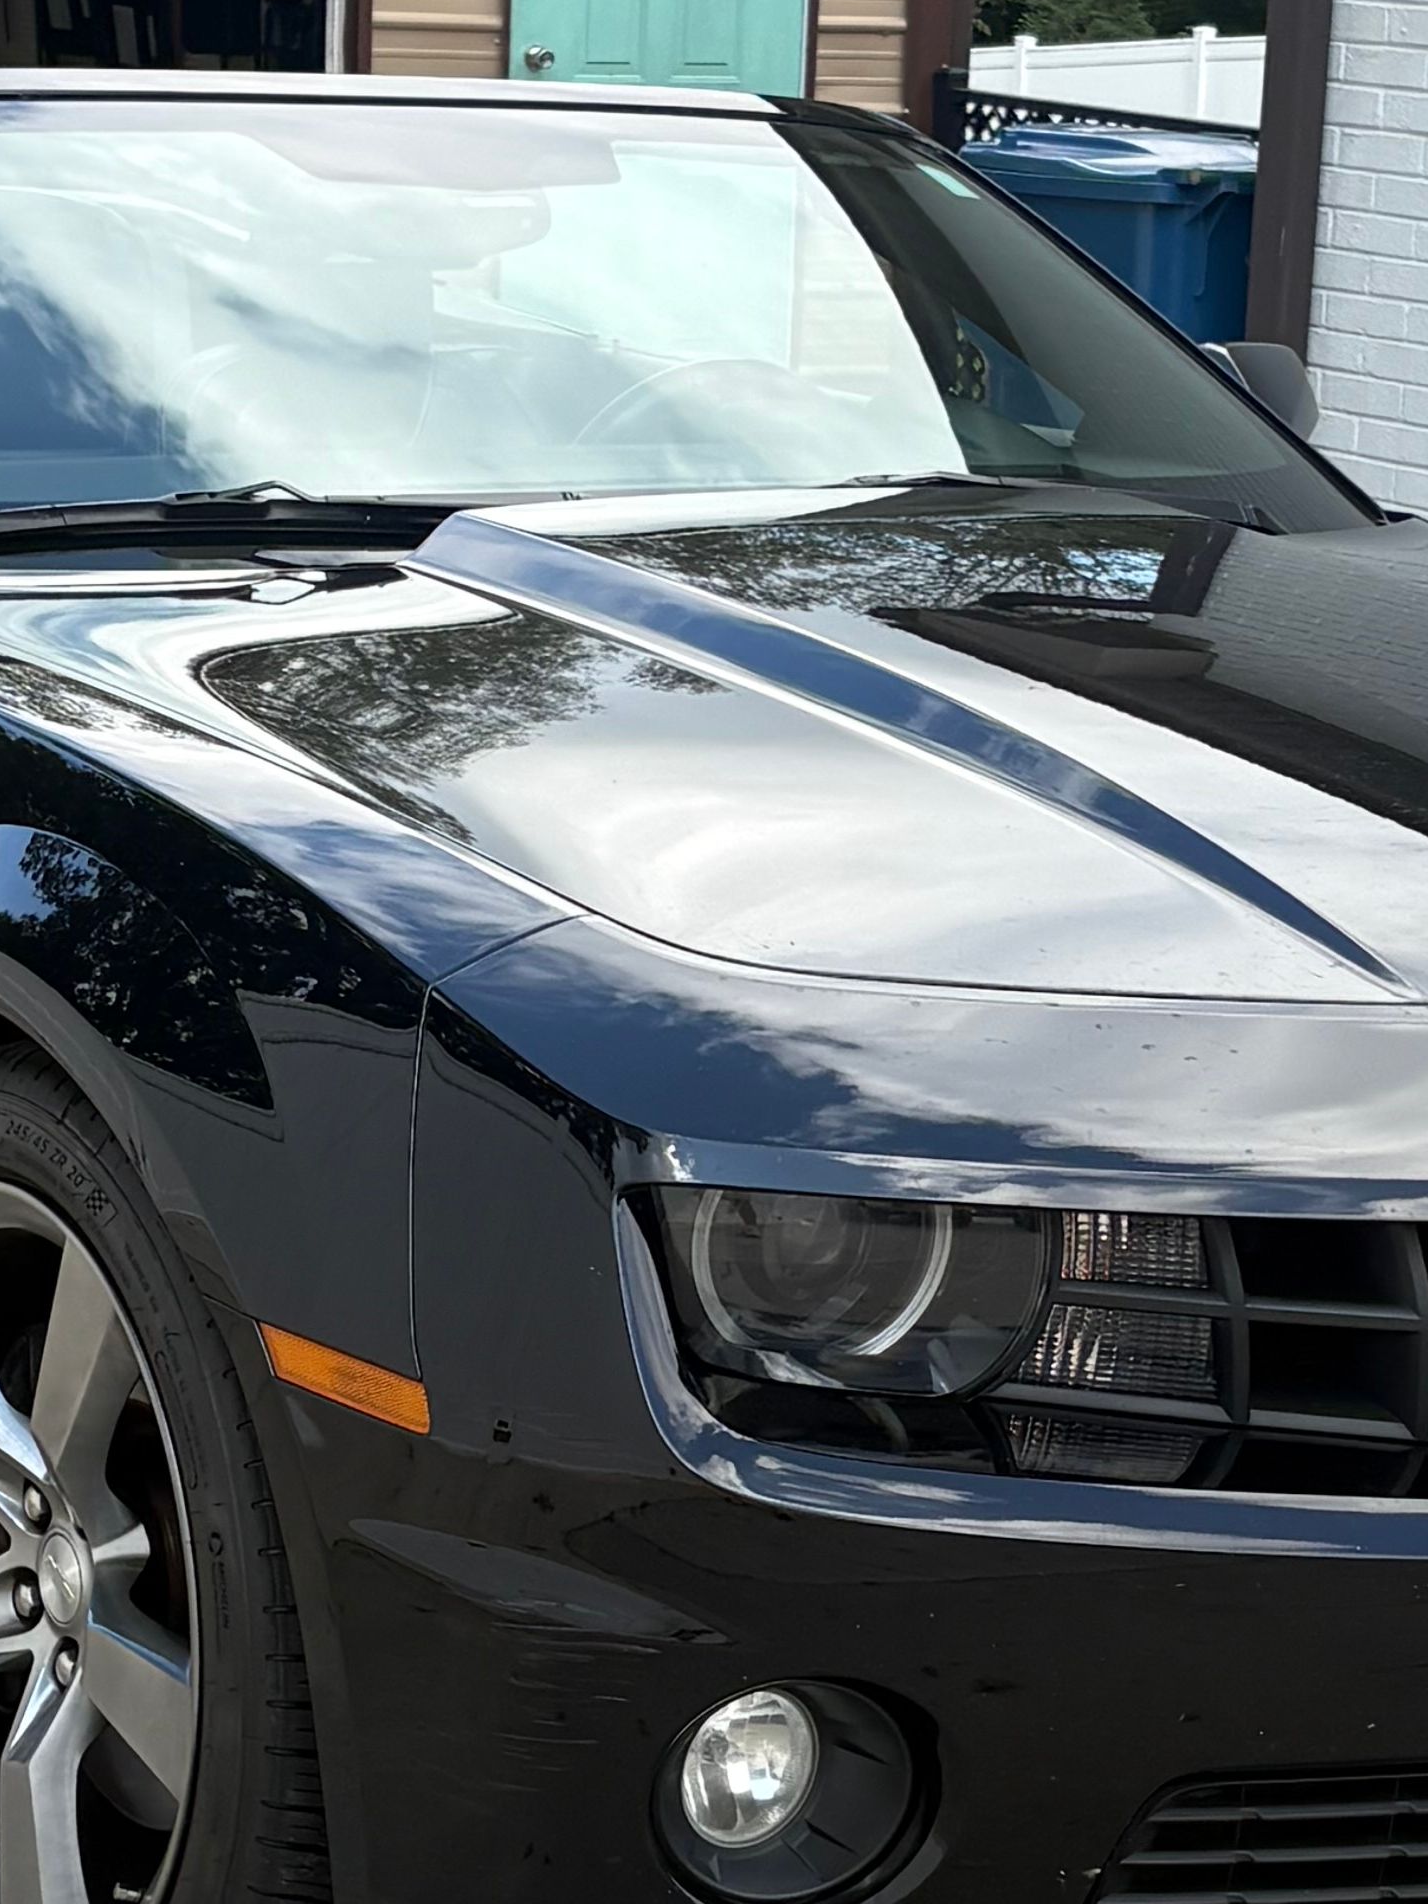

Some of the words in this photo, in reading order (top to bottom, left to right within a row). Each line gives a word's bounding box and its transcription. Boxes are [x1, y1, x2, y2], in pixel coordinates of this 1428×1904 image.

[5, 1120, 50, 1154] 245/45
[49, 1147, 68, 1171] ZR
[66, 1165, 85, 1188] 20
